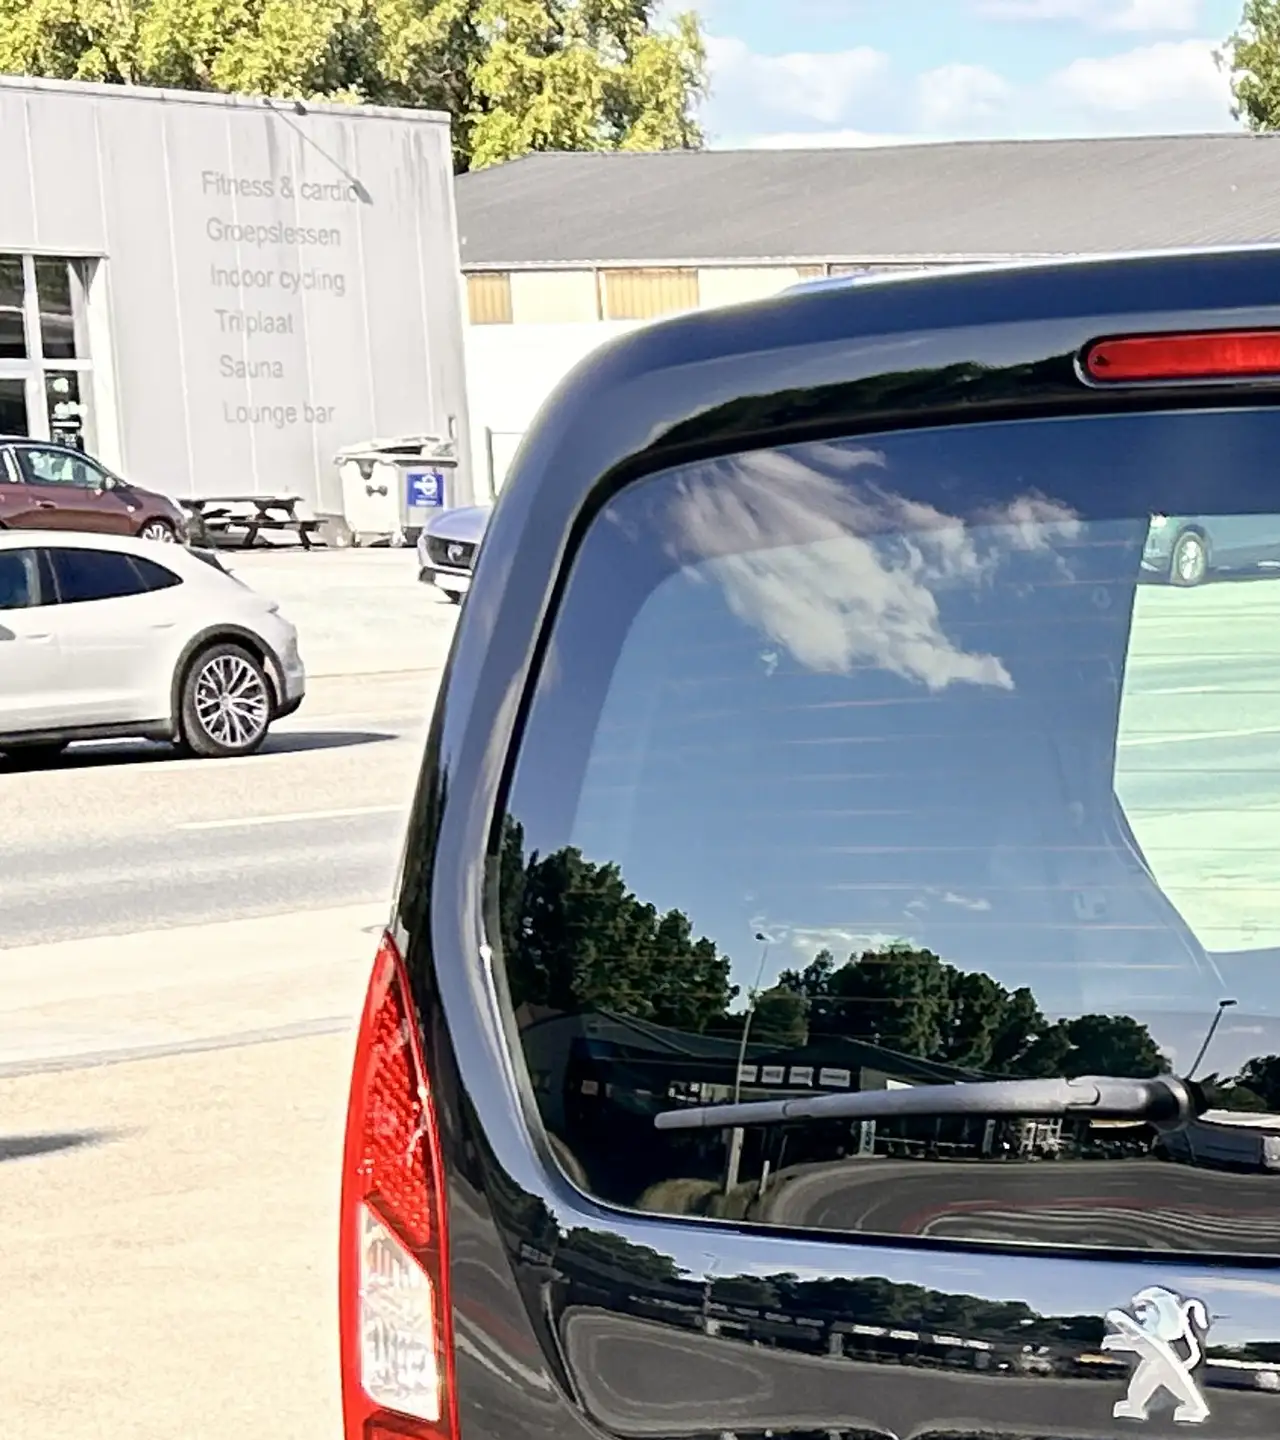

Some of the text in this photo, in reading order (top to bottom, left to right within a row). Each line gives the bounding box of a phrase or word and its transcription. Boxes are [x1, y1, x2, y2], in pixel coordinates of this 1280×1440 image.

[201, 170, 275, 198] Fitness
[280, 175, 295, 199] &
[206, 217, 342, 249] Groepslessen
[210, 263, 346, 297] Indoor cycling
[219, 353, 284, 379] Sauna
[222, 400, 336, 429] Lounge bar
